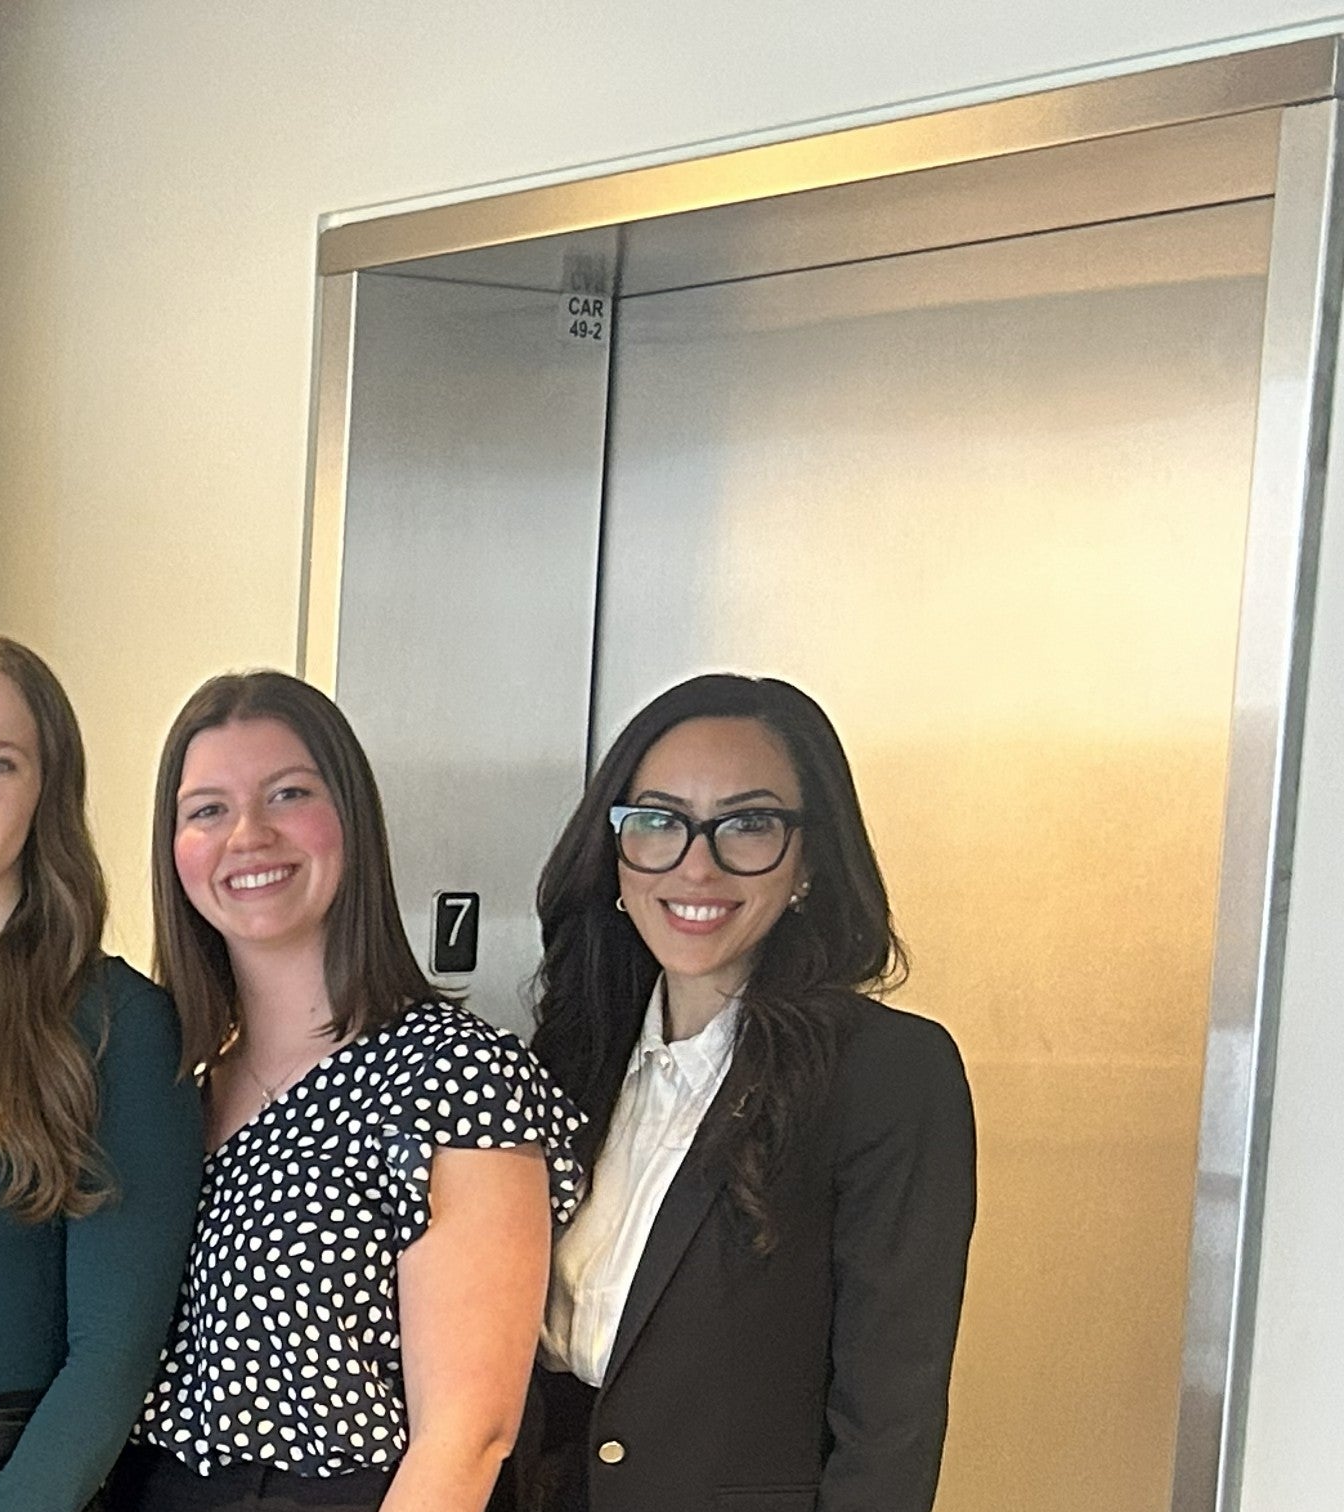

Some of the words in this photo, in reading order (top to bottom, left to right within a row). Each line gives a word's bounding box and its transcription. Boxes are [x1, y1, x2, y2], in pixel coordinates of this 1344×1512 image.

[568, 296, 604, 318] CAR
[569, 320, 603, 340] 49-2
[445, 898, 472, 947] 7
